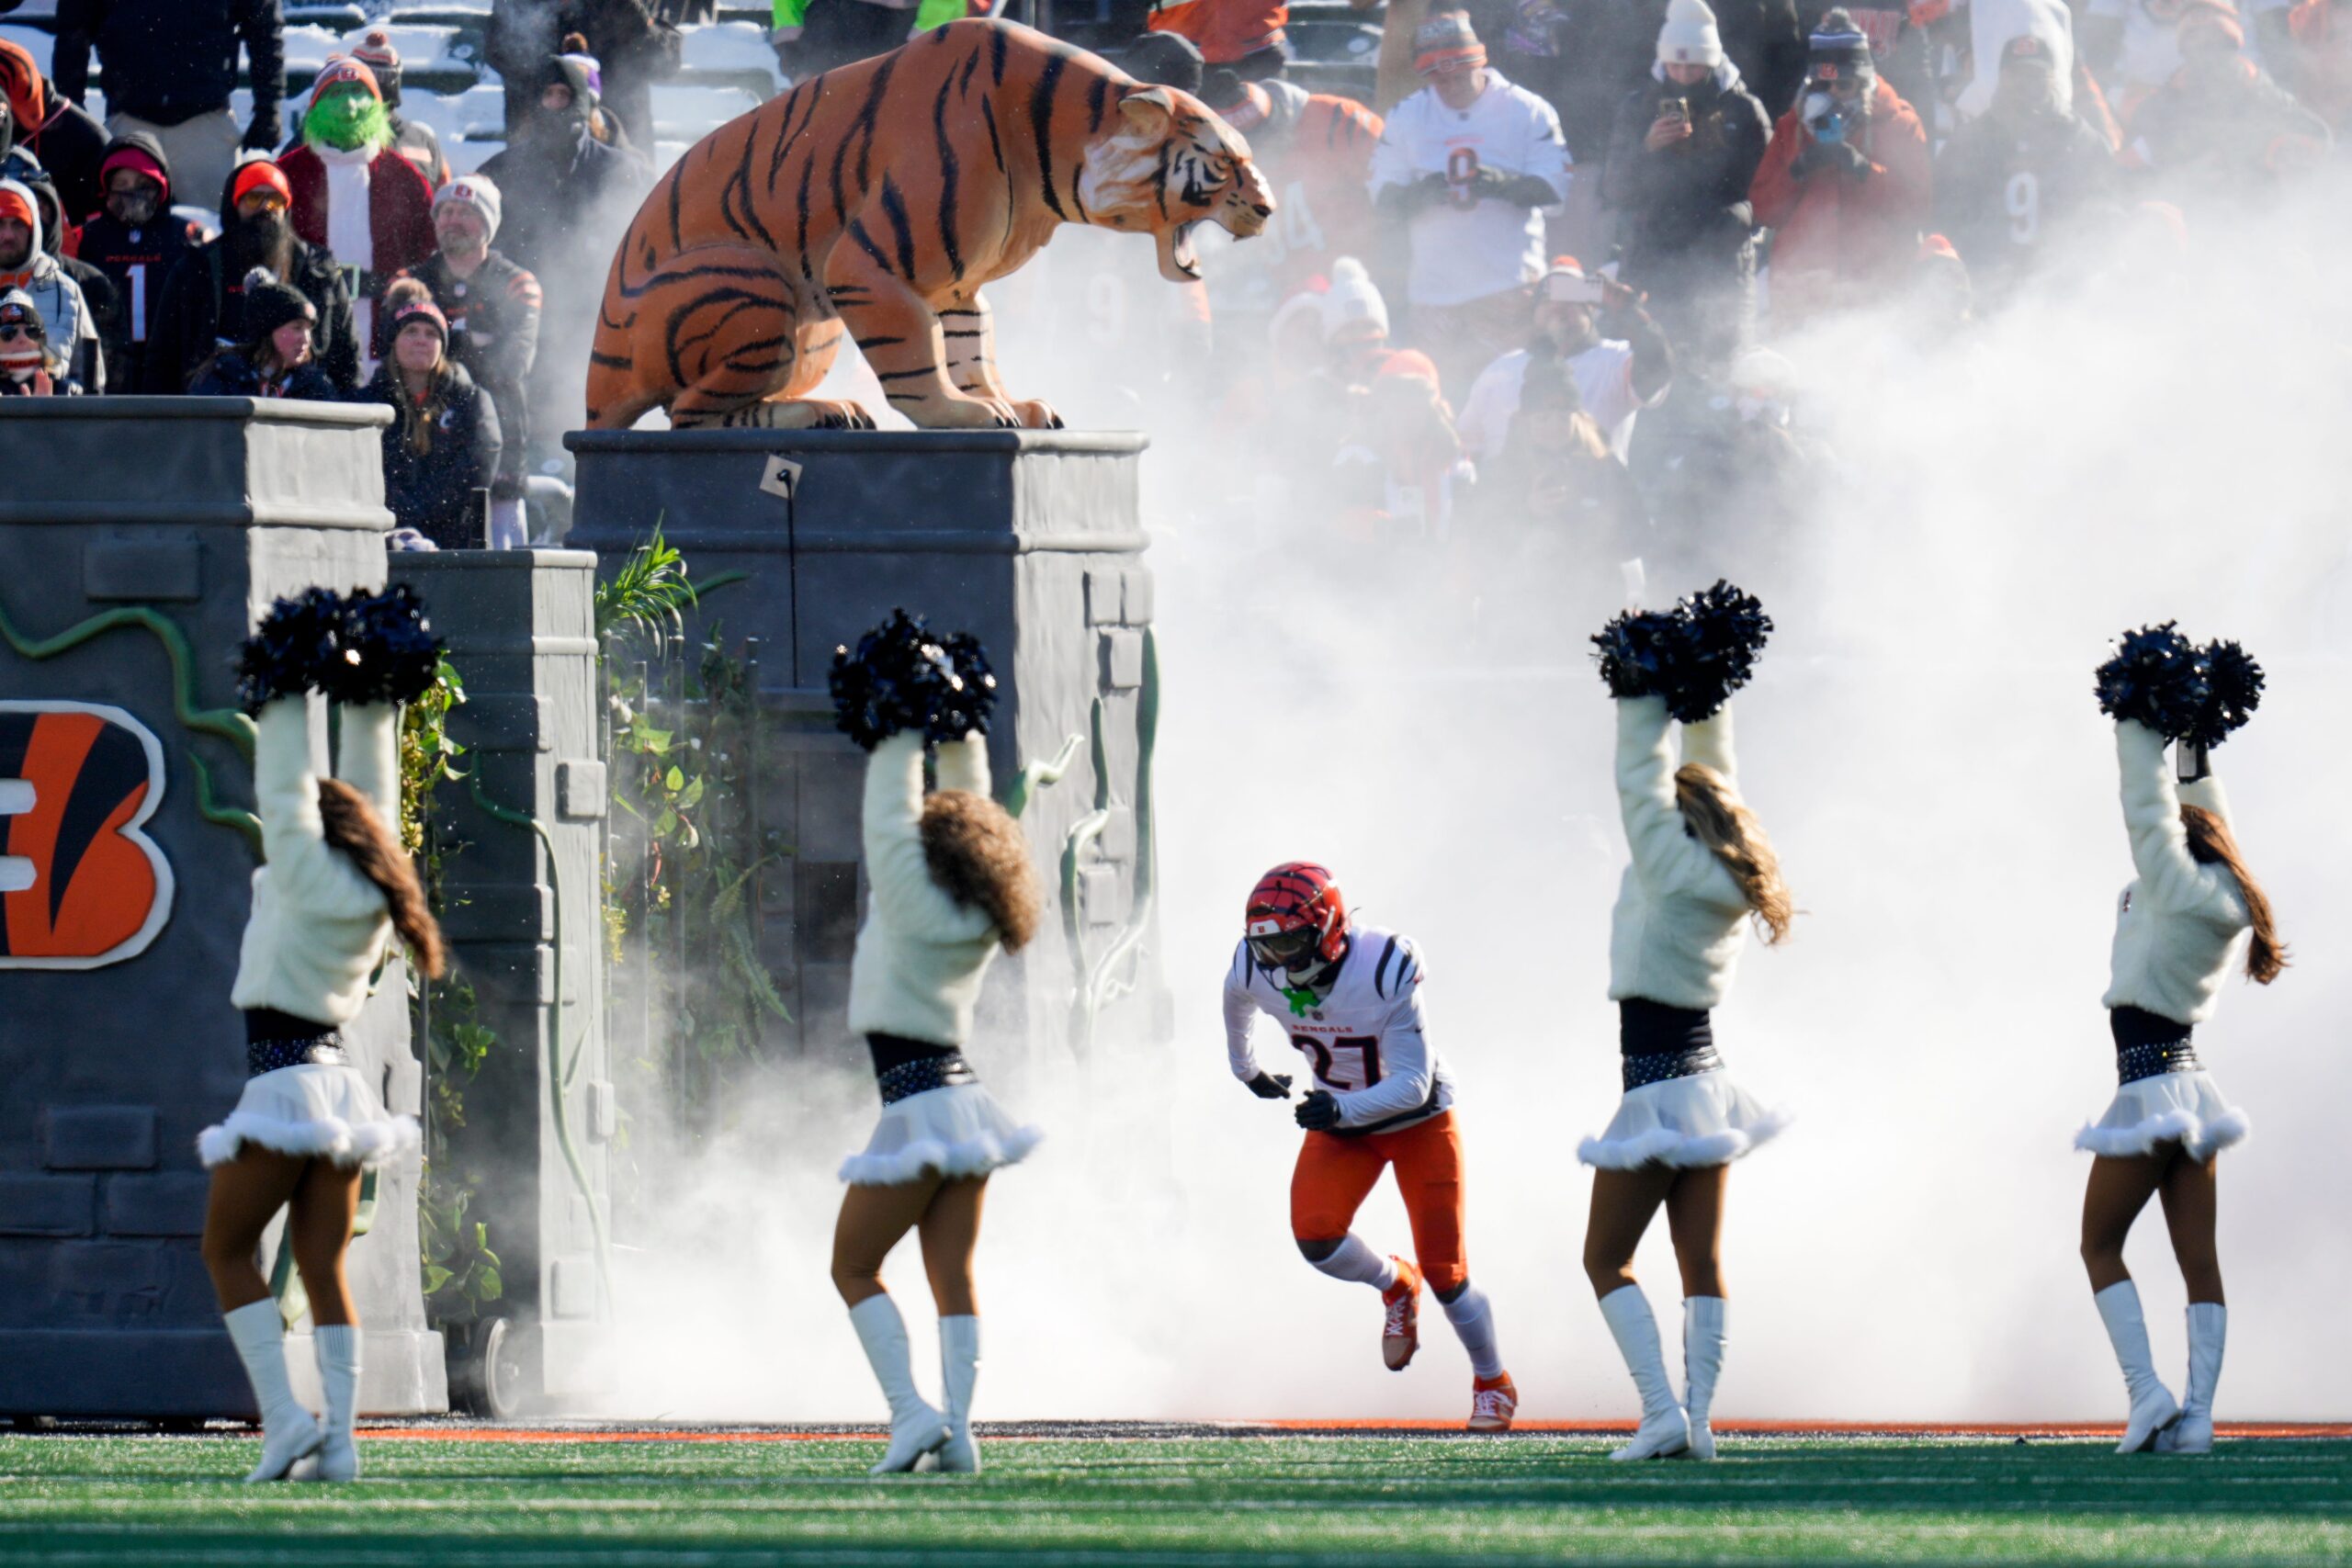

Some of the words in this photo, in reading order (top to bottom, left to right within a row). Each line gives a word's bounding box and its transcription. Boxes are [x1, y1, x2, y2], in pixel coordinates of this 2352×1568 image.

[2005, 172, 2039, 245] 9
[125, 264, 146, 342] 1
[1086, 272, 1129, 348] 9
[1291, 1034, 1382, 1091] 27
[1292, 1024, 1353, 1033] BENGALS
